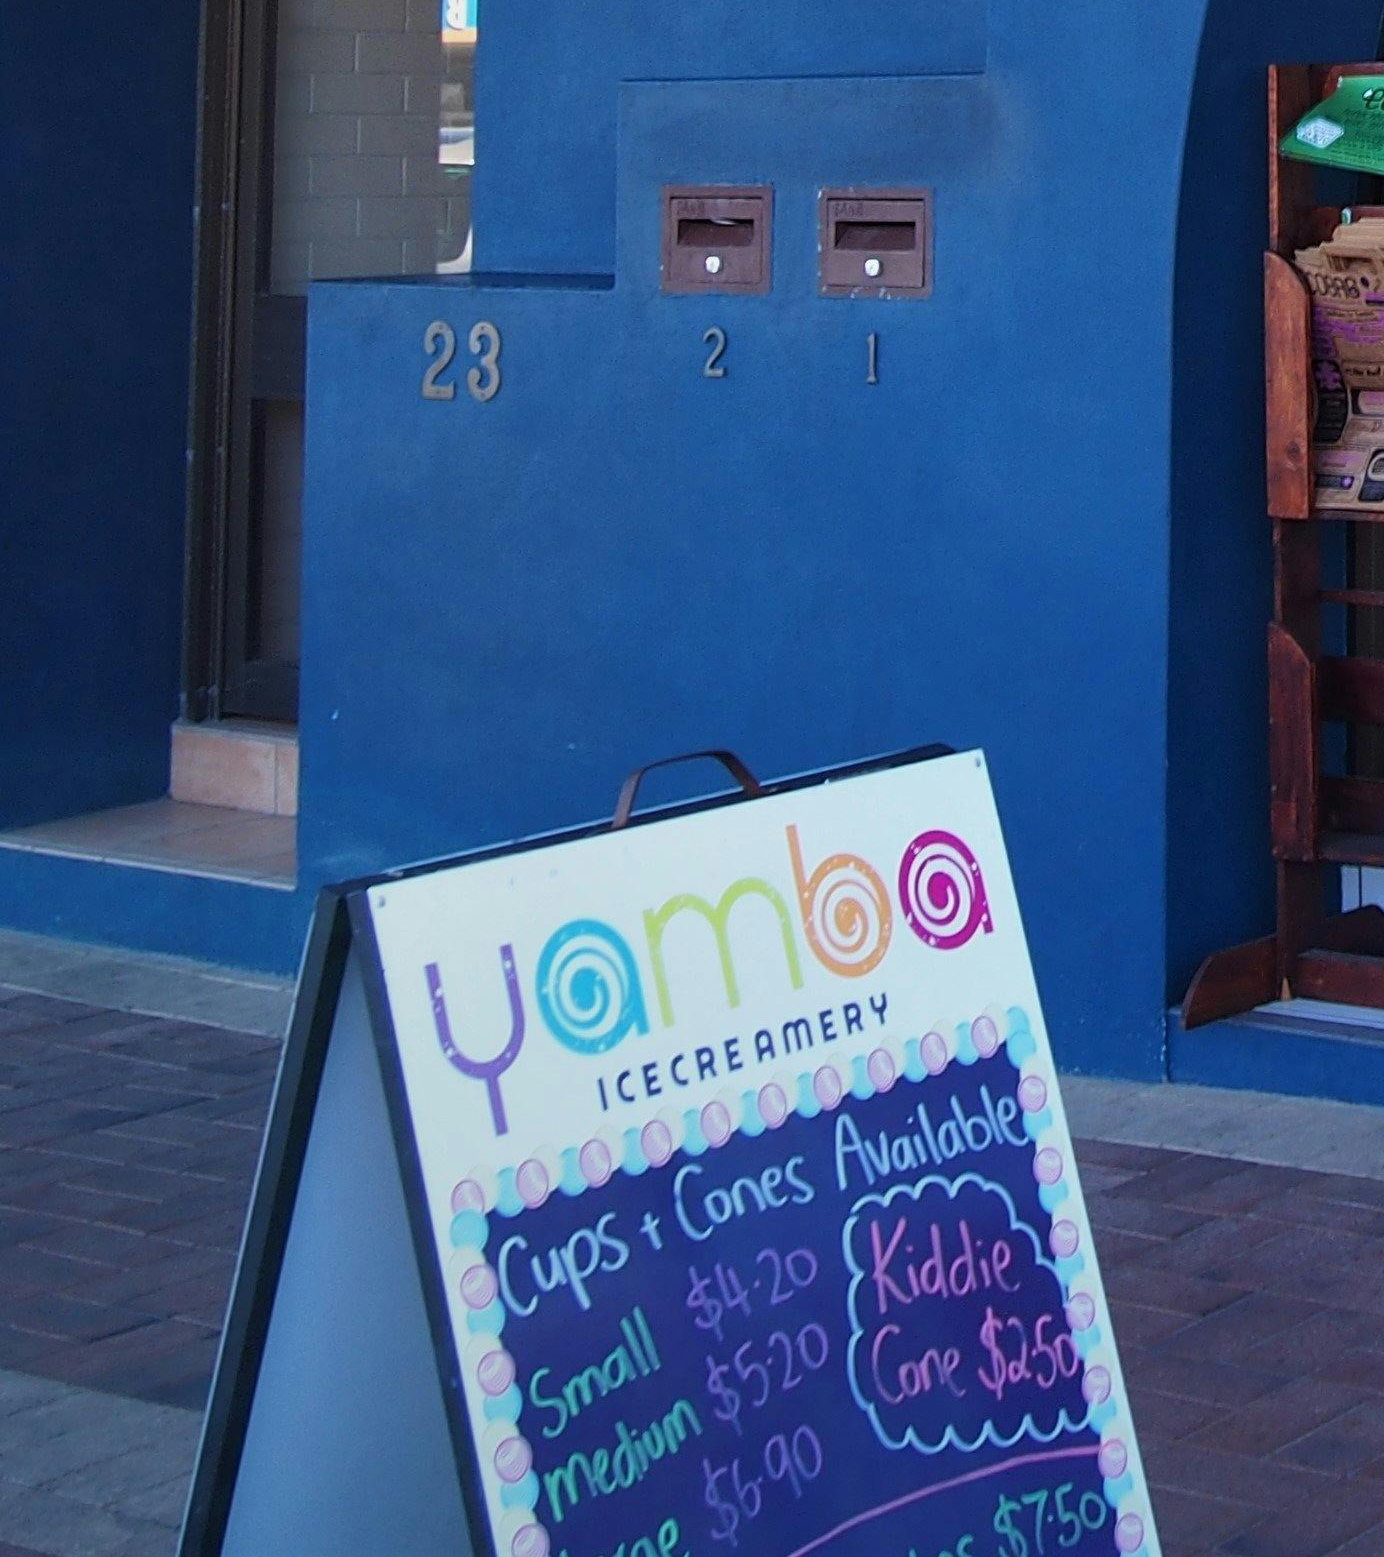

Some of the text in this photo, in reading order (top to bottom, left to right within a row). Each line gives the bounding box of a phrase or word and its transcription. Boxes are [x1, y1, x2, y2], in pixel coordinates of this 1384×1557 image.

[421, 319, 503, 403] 23
[702, 325, 729, 379] 2
[595, 991, 892, 1112] ICECREAMERY
[497, 1212, 631, 1319] Cups
[673, 1158, 815, 1243] Cones
[834, 1085, 1030, 1192] Available
[871, 1217, 1022, 1314] Kiddie
[528, 1308, 662, 1441] Small
[870, 1323, 966, 1406] Cone
